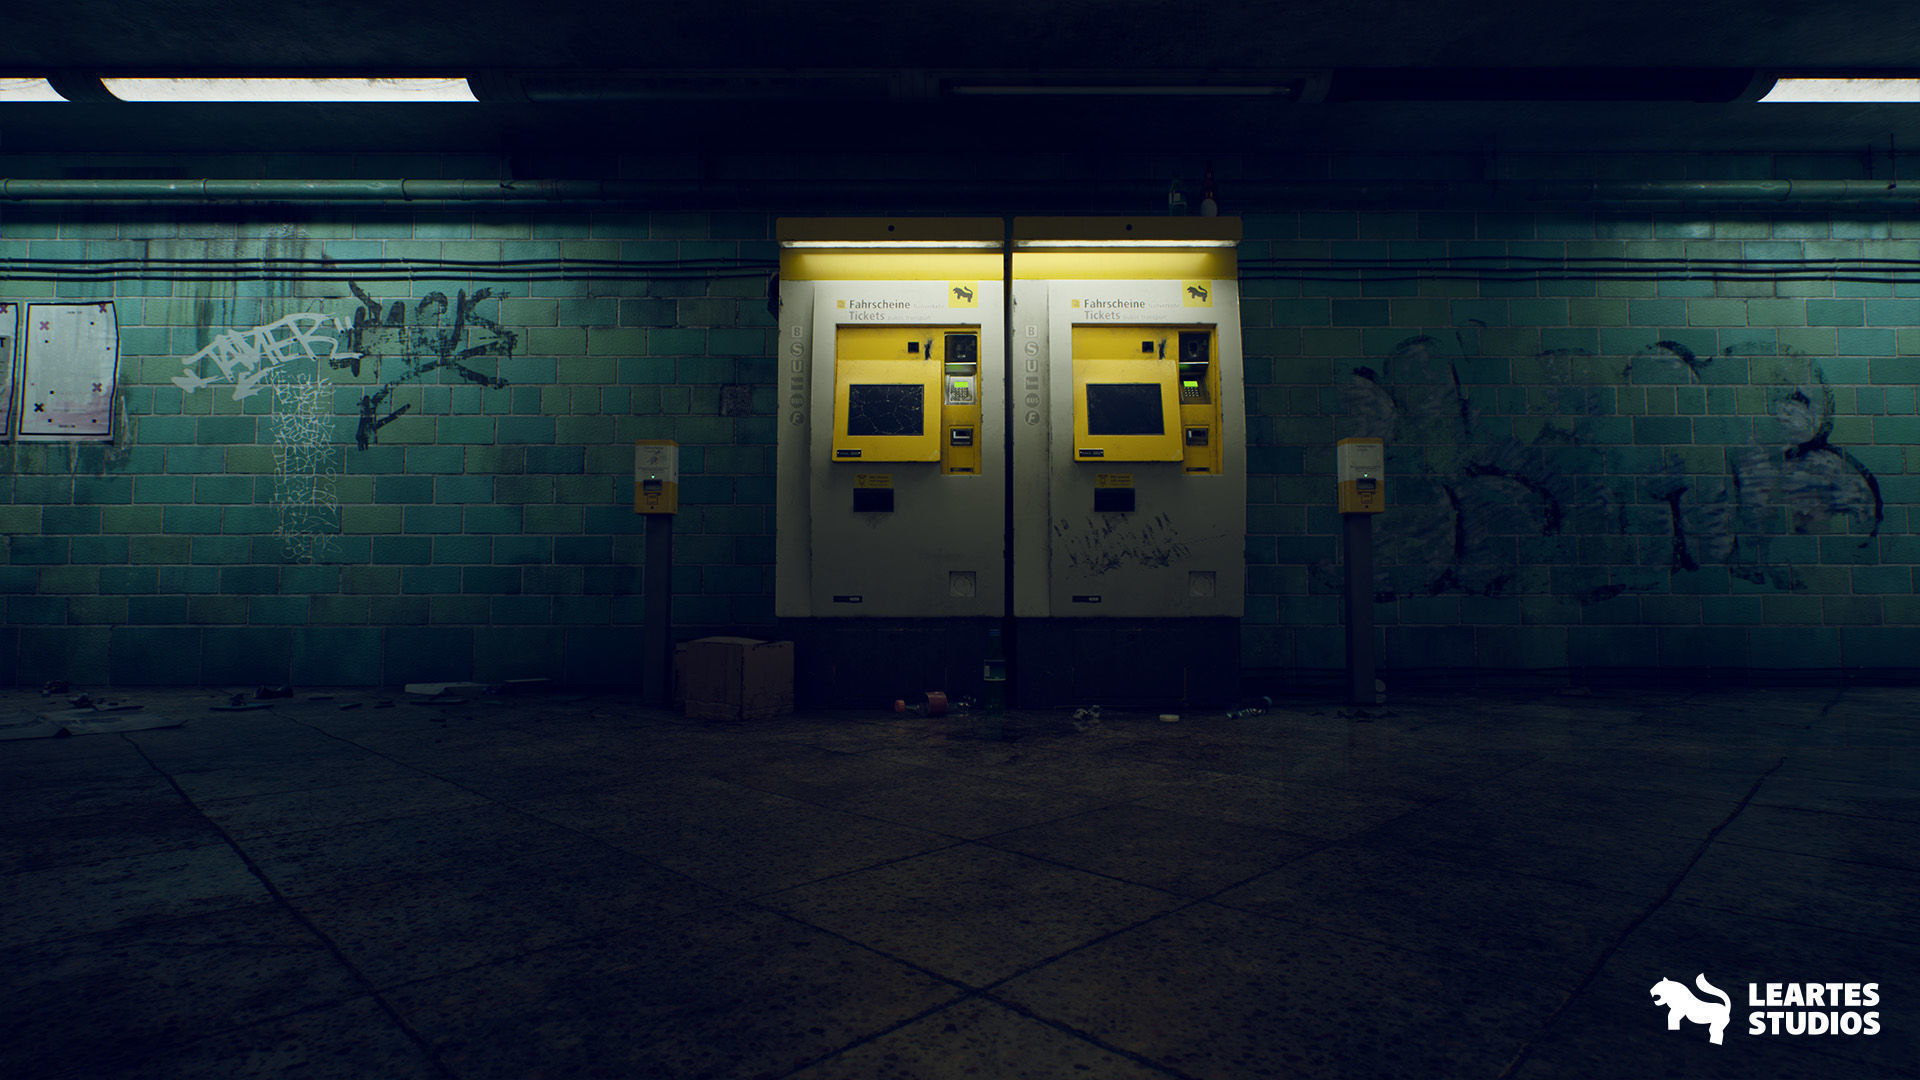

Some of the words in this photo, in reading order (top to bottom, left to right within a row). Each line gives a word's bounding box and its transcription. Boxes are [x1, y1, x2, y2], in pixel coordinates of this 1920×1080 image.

[849, 299, 911, 309] Fahrscheine
[1084, 299, 1146, 309] Fahrscheine
[849, 310, 885, 320] Tickets
[1084, 310, 1121, 320] Tickets
[792, 343, 802, 355] S
[1026, 343, 1037, 355] S
[792, 360, 802, 372] U
[1027, 360, 1037, 372] U
